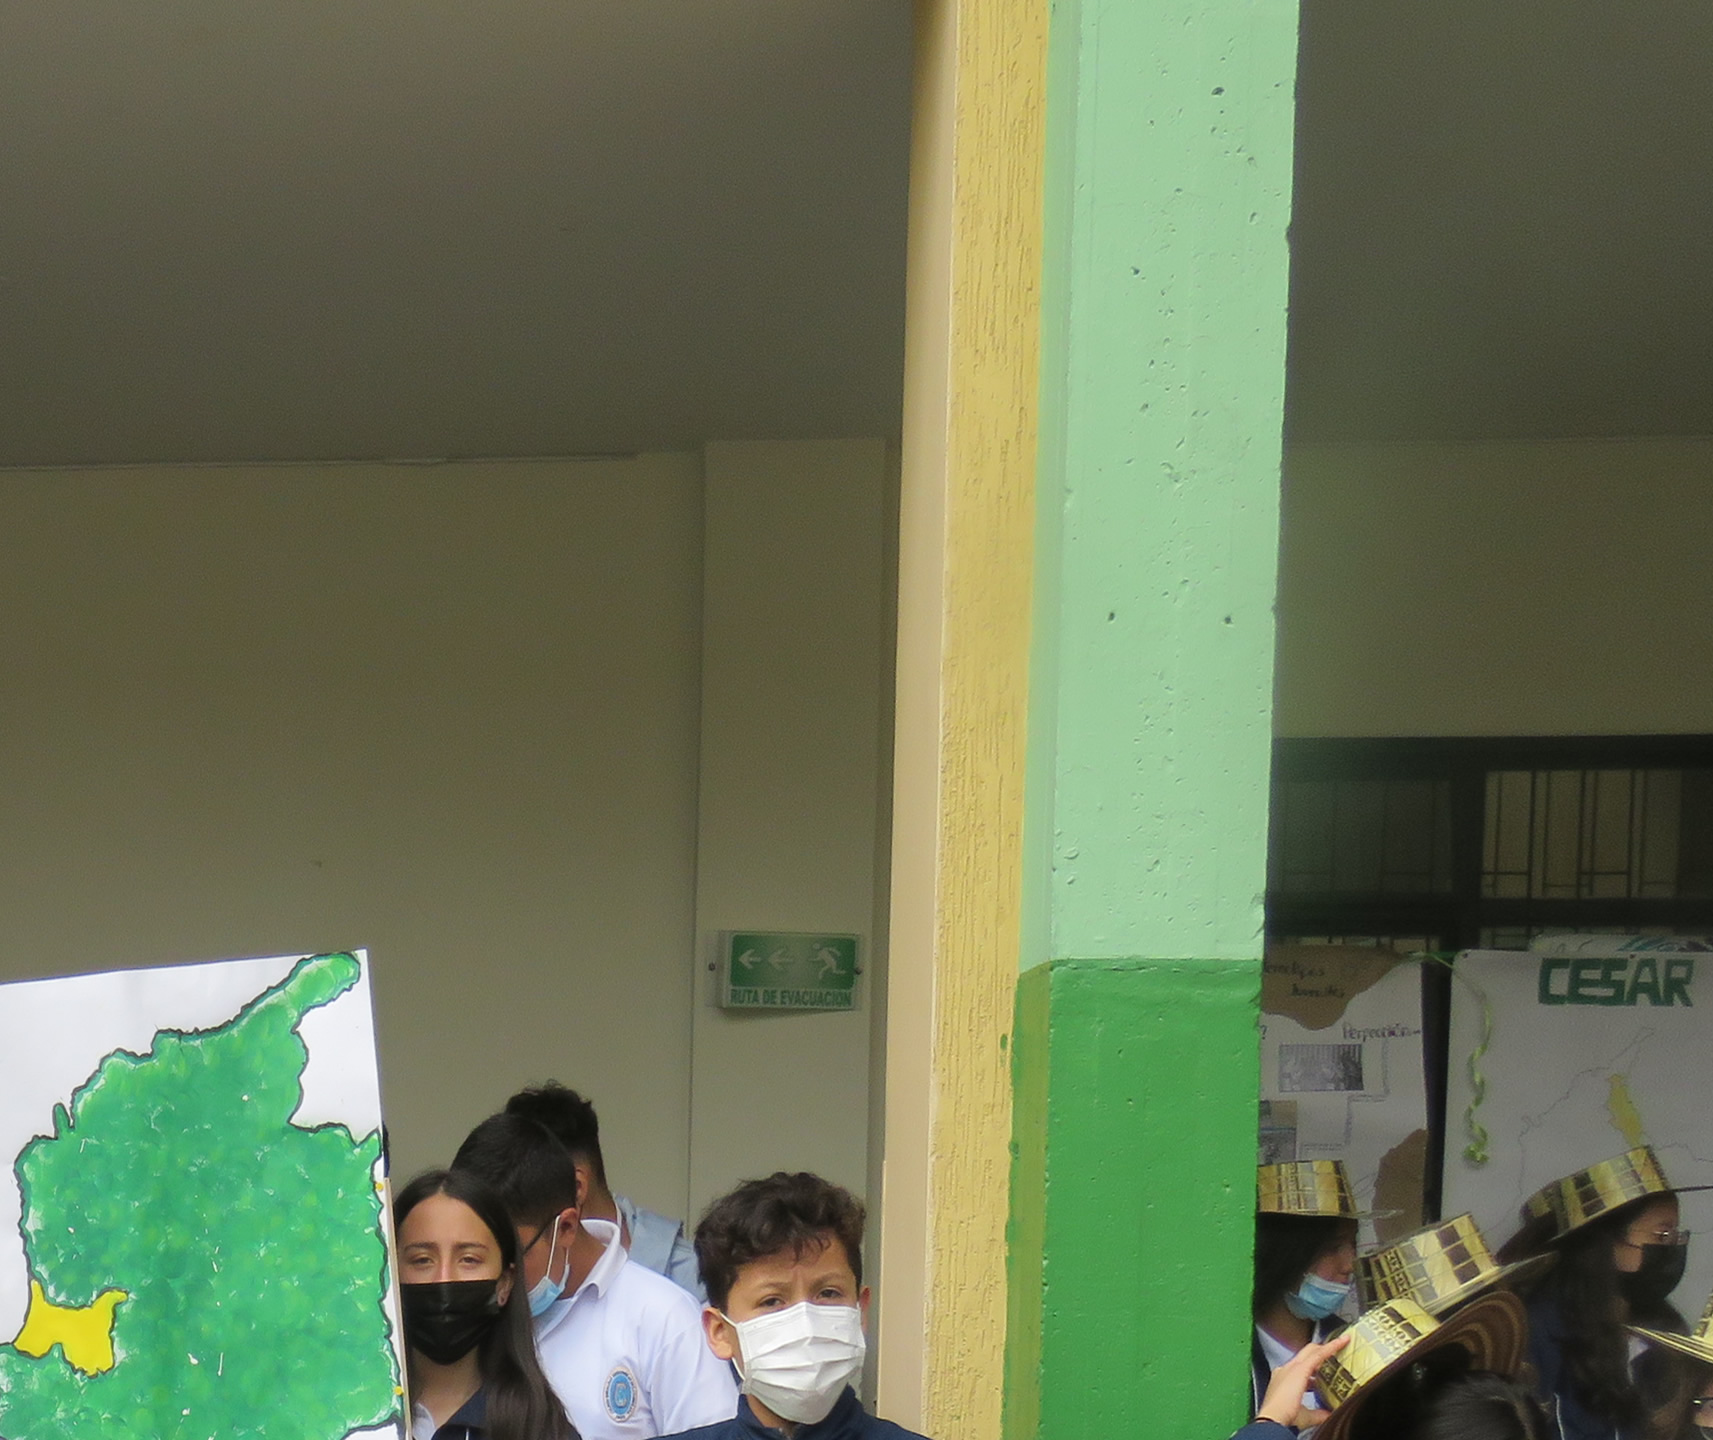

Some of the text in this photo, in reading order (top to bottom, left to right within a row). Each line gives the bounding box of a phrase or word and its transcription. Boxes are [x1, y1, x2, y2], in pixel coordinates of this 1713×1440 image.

[730, 987, 759, 1005] RUTA
[762, 988, 778, 1006] DE
[1537, 956, 1695, 1008] CESAR
